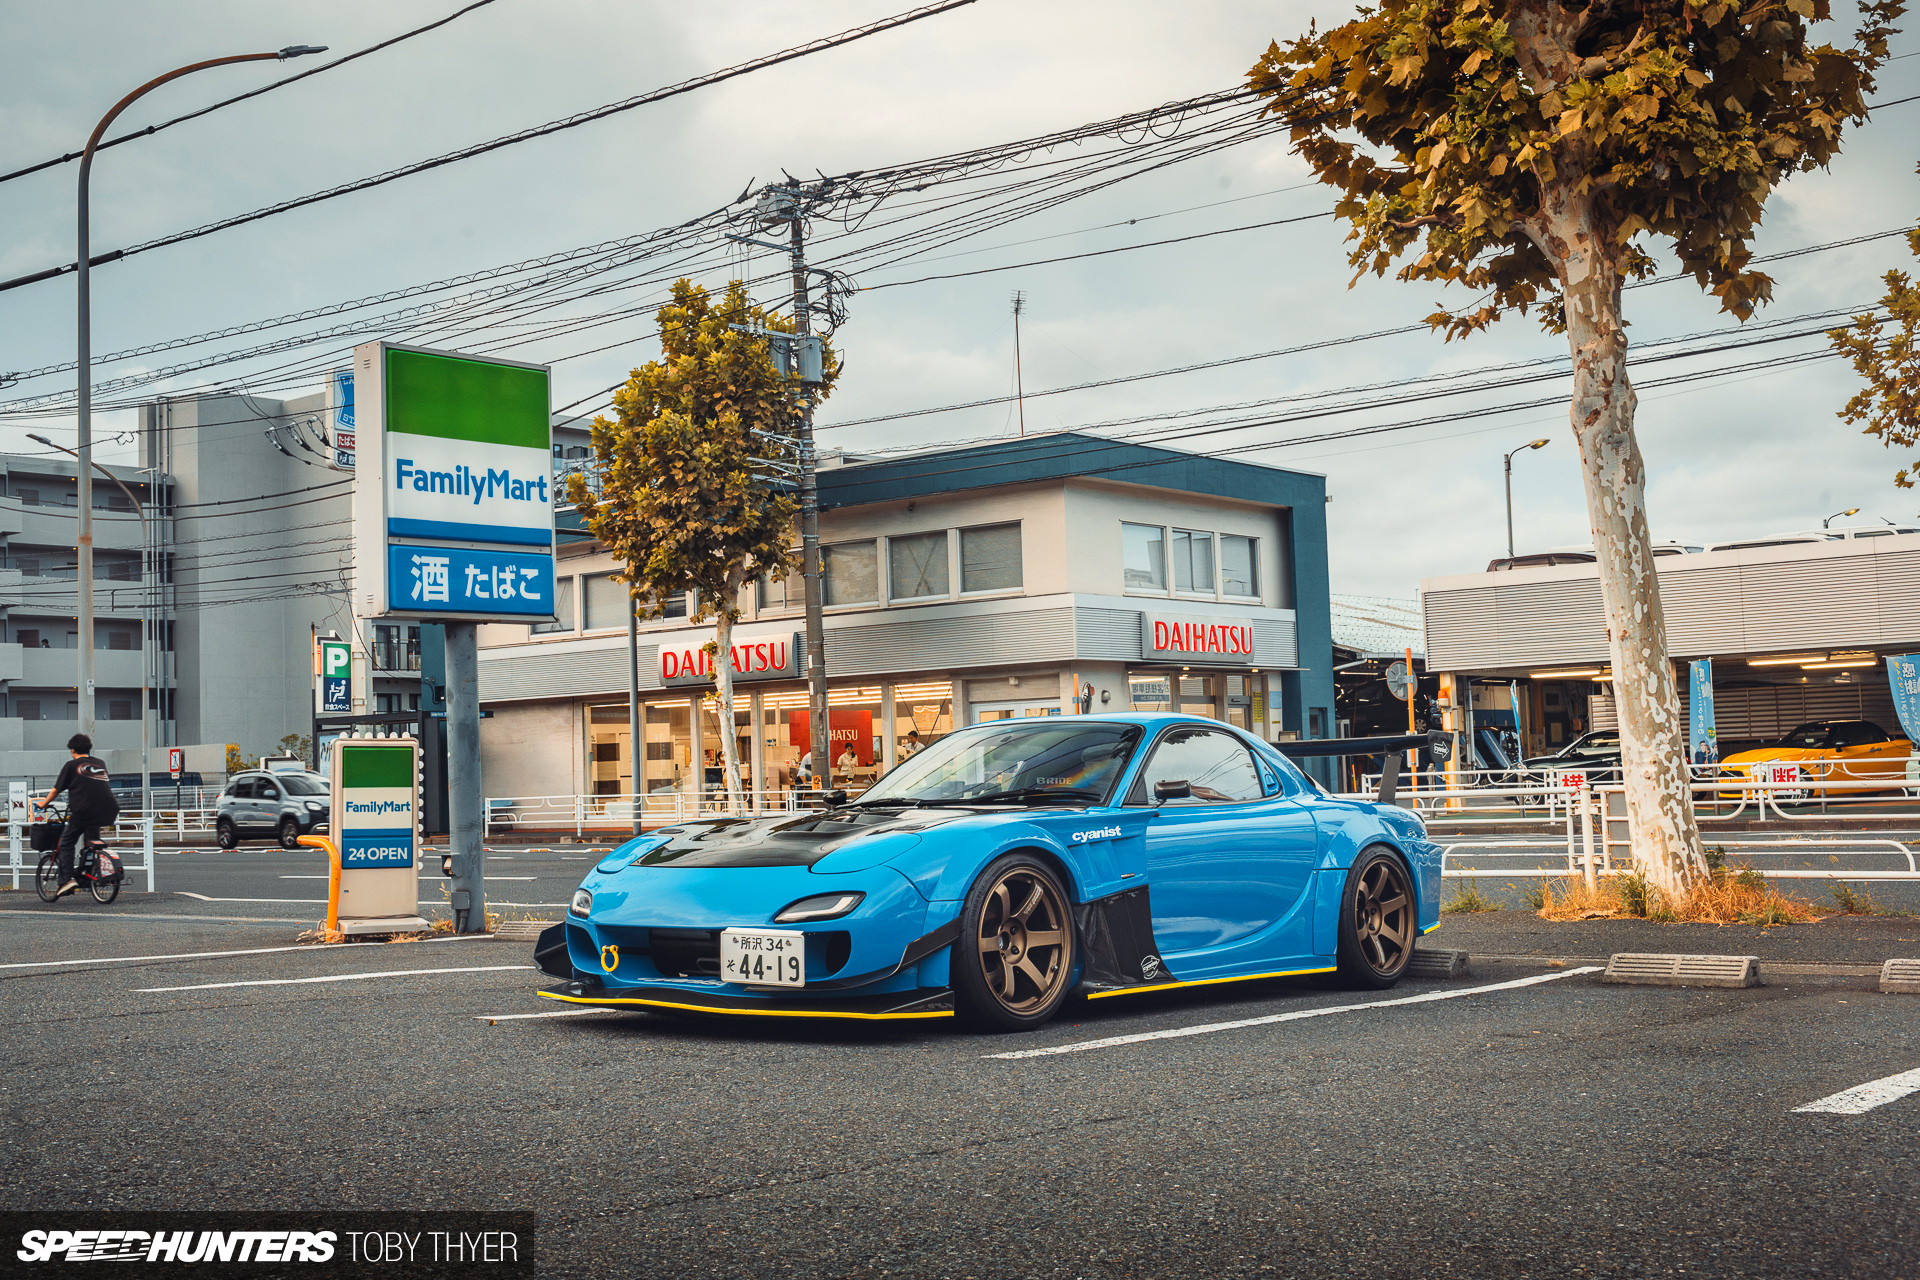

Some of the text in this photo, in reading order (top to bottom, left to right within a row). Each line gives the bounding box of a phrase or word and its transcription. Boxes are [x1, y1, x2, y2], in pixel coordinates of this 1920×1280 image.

[396, 458, 548, 505] FamilyMart
[410, 554, 541, 602] 酒 たばこ
[1153, 620, 1252, 655] DAIHATSU
[326, 647, 349, 675] P
[1036, 776, 1073, 785] BRIDE
[345, 800, 411, 816] FamilyMart
[1071, 825, 1122, 843] cyanist
[348, 847, 408, 861] 24 OPEN
[740, 936, 784, 952] 所沢 34
[726, 959, 736, 973] そ
[739, 953, 800, 982] 44-19
